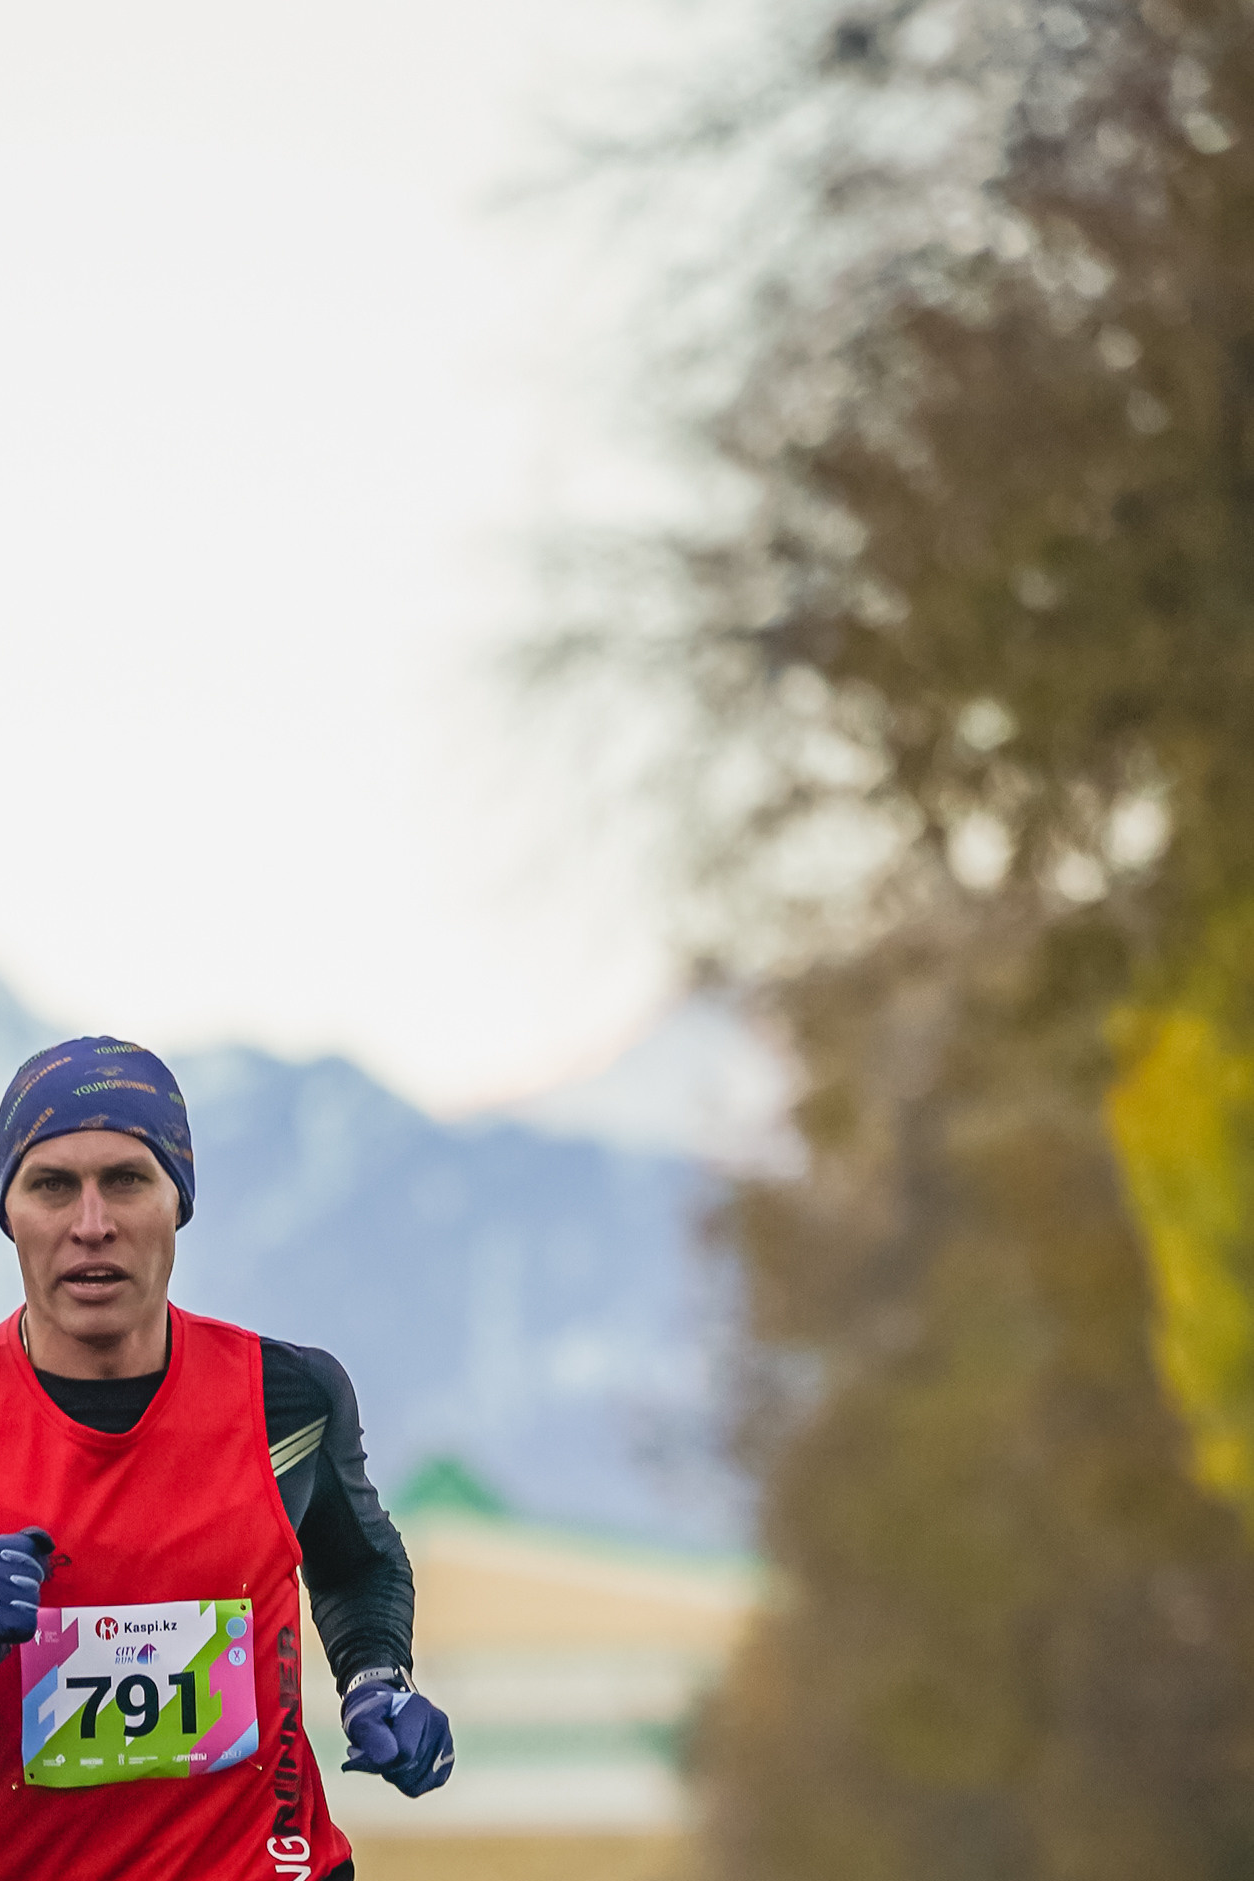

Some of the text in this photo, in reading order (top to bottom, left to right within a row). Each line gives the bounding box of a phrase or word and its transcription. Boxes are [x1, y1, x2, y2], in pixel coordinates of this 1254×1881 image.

[72, 1079, 158, 1097] YOUNGRUNNER
[124, 1620, 178, 1635] Kaspi.kz
[115, 1646, 137, 1657] CITY
[114, 1656, 134, 1665] RUN
[66, 1671, 197, 1740] 791
